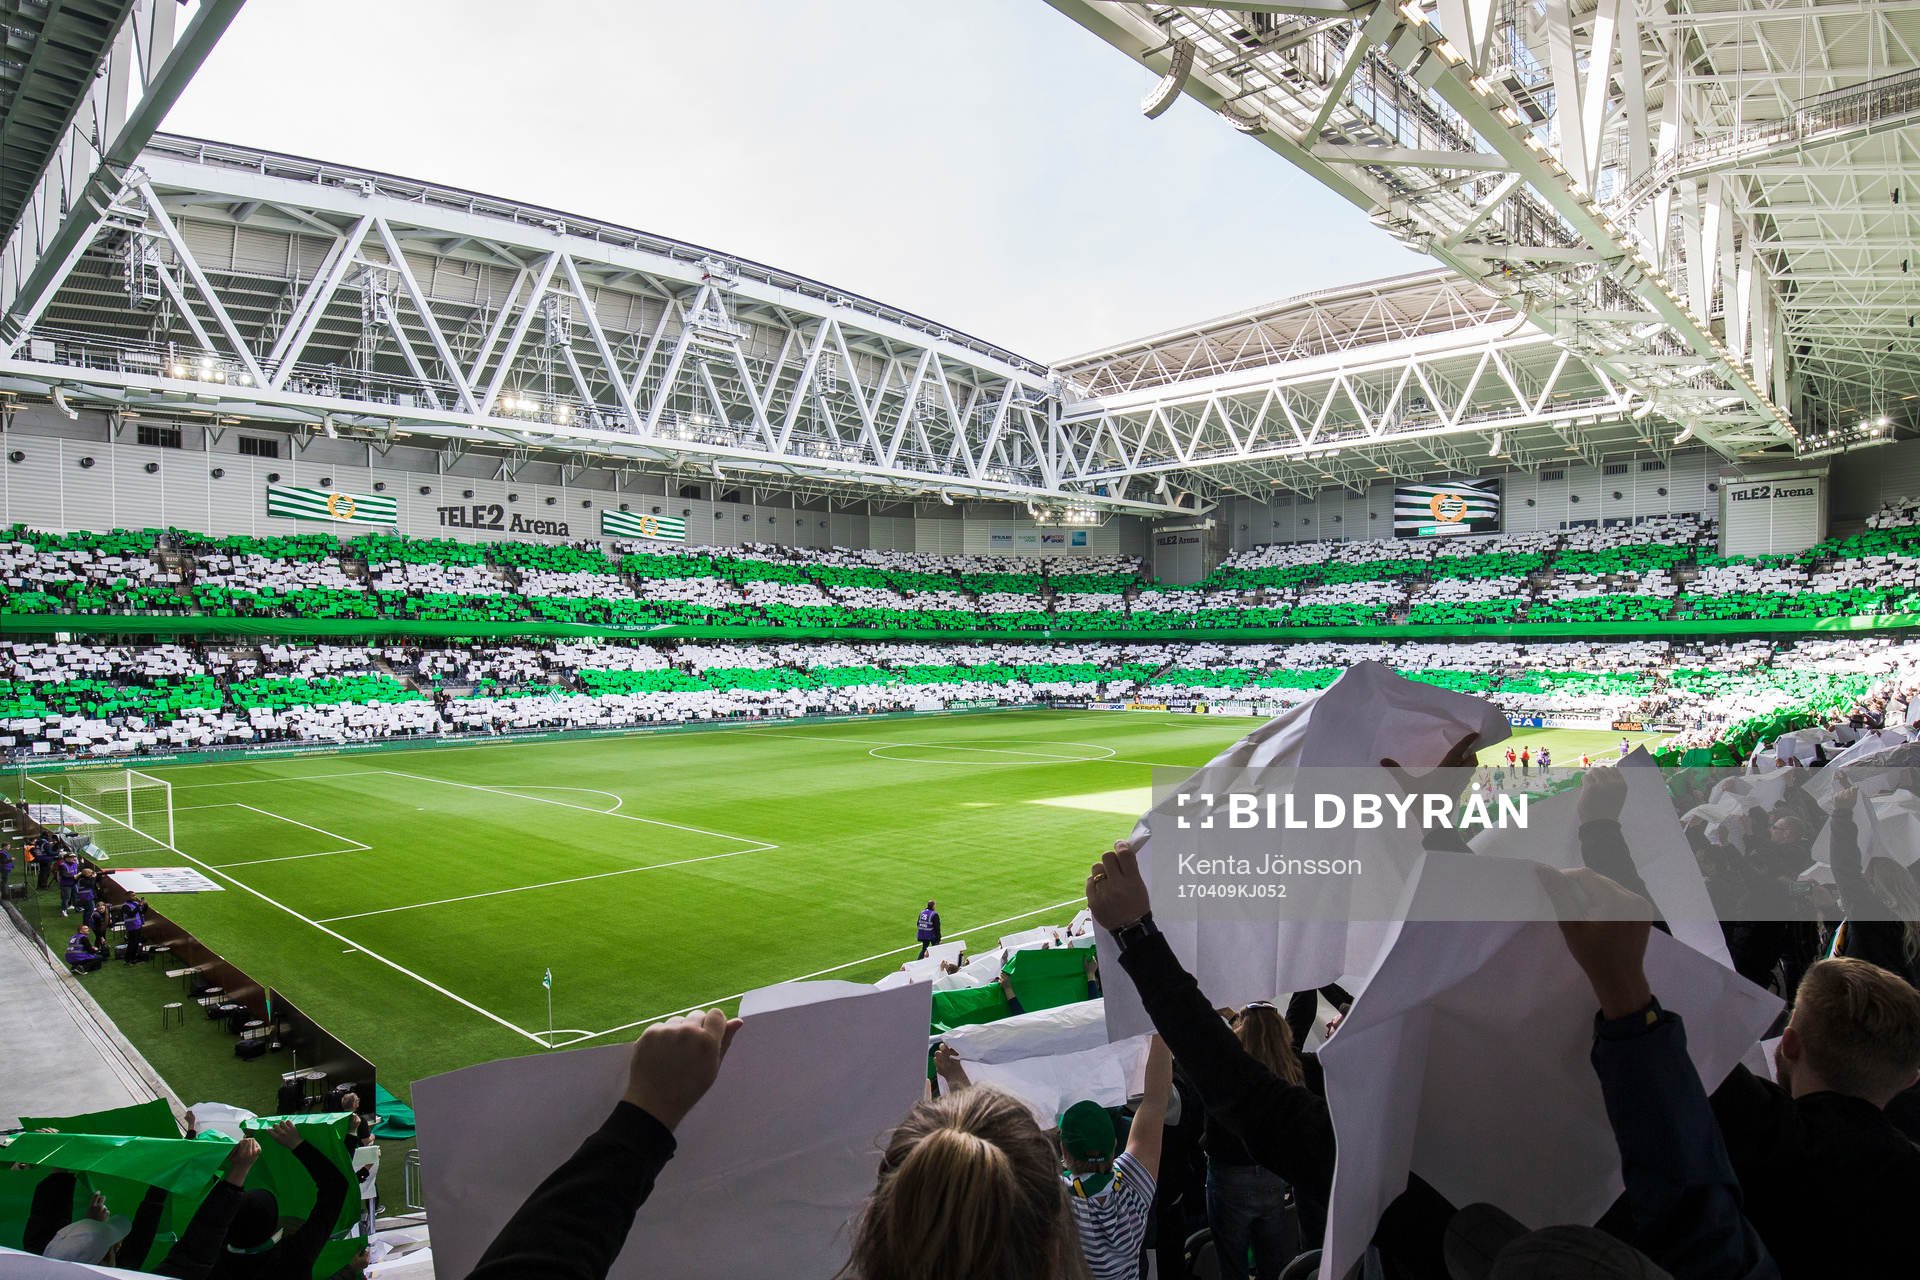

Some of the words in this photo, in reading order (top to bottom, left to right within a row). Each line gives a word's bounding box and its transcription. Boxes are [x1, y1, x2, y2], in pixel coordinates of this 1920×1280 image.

[1731, 486, 1771, 501] TELE2
[1773, 488, 1814, 498] Arena
[437, 504, 504, 531] TELE2
[509, 513, 570, 537] Arena
[1157, 535, 1178, 546] TELE2
[1179, 537, 1200, 545] Arena
